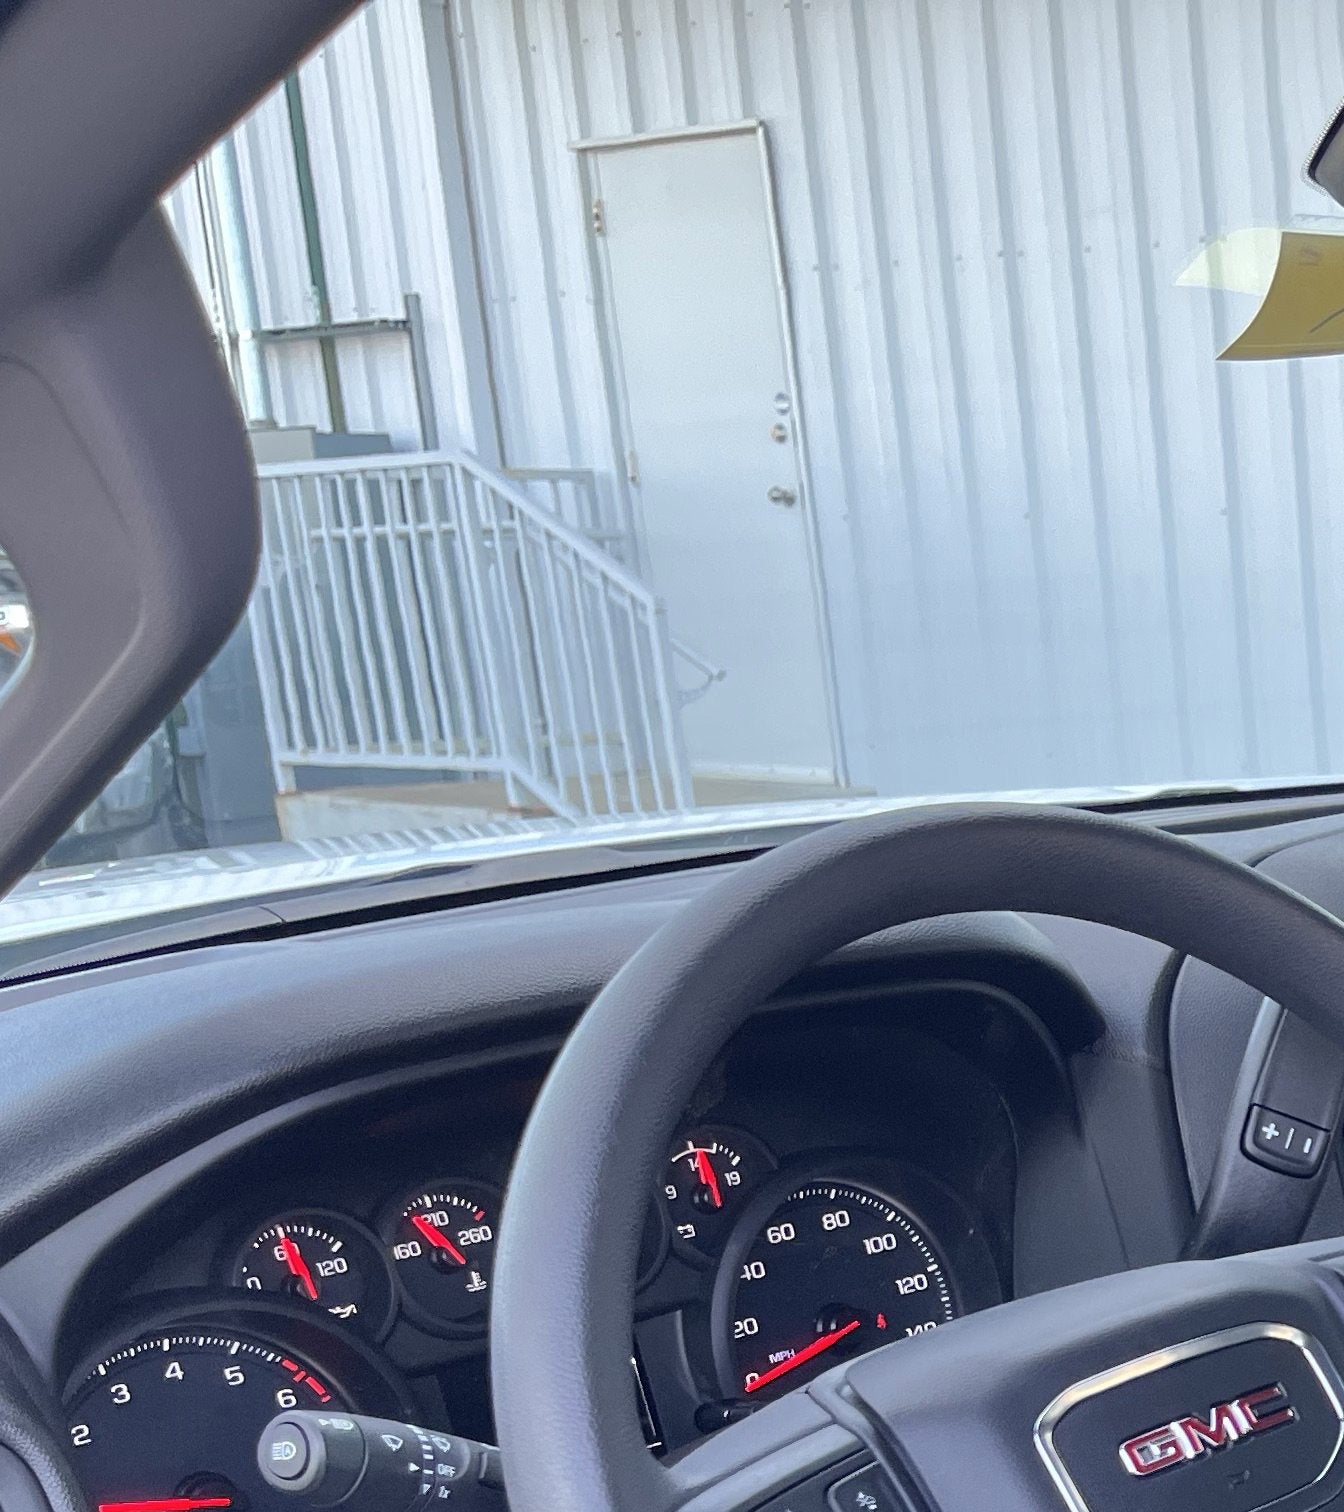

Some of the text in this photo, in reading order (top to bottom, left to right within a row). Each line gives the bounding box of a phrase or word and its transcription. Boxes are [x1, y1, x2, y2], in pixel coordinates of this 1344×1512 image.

[724, 1171, 742, 1187] 19
[821, 1210, 851, 1232] 80
[458, 1223, 493, 1246] 260
[766, 1222, 796, 1244] 60
[863, 1232, 897, 1255] 100
[392, 1240, 423, 1262] 160
[315, 1256, 349, 1278] 120
[895, 1273, 929, 1296] 120
[734, 1316, 760, 1339] 20
[768, 1347, 797, 1365] MPH
[165, 1361, 185, 1383] 4
[223, 1366, 246, 1387] 5
[109, 1383, 132, 1405] 3
[275, 1388, 298, 1409] 6
[70, 1423, 93, 1447] 2
[1117, 1381, 1300, 1478] GMC
